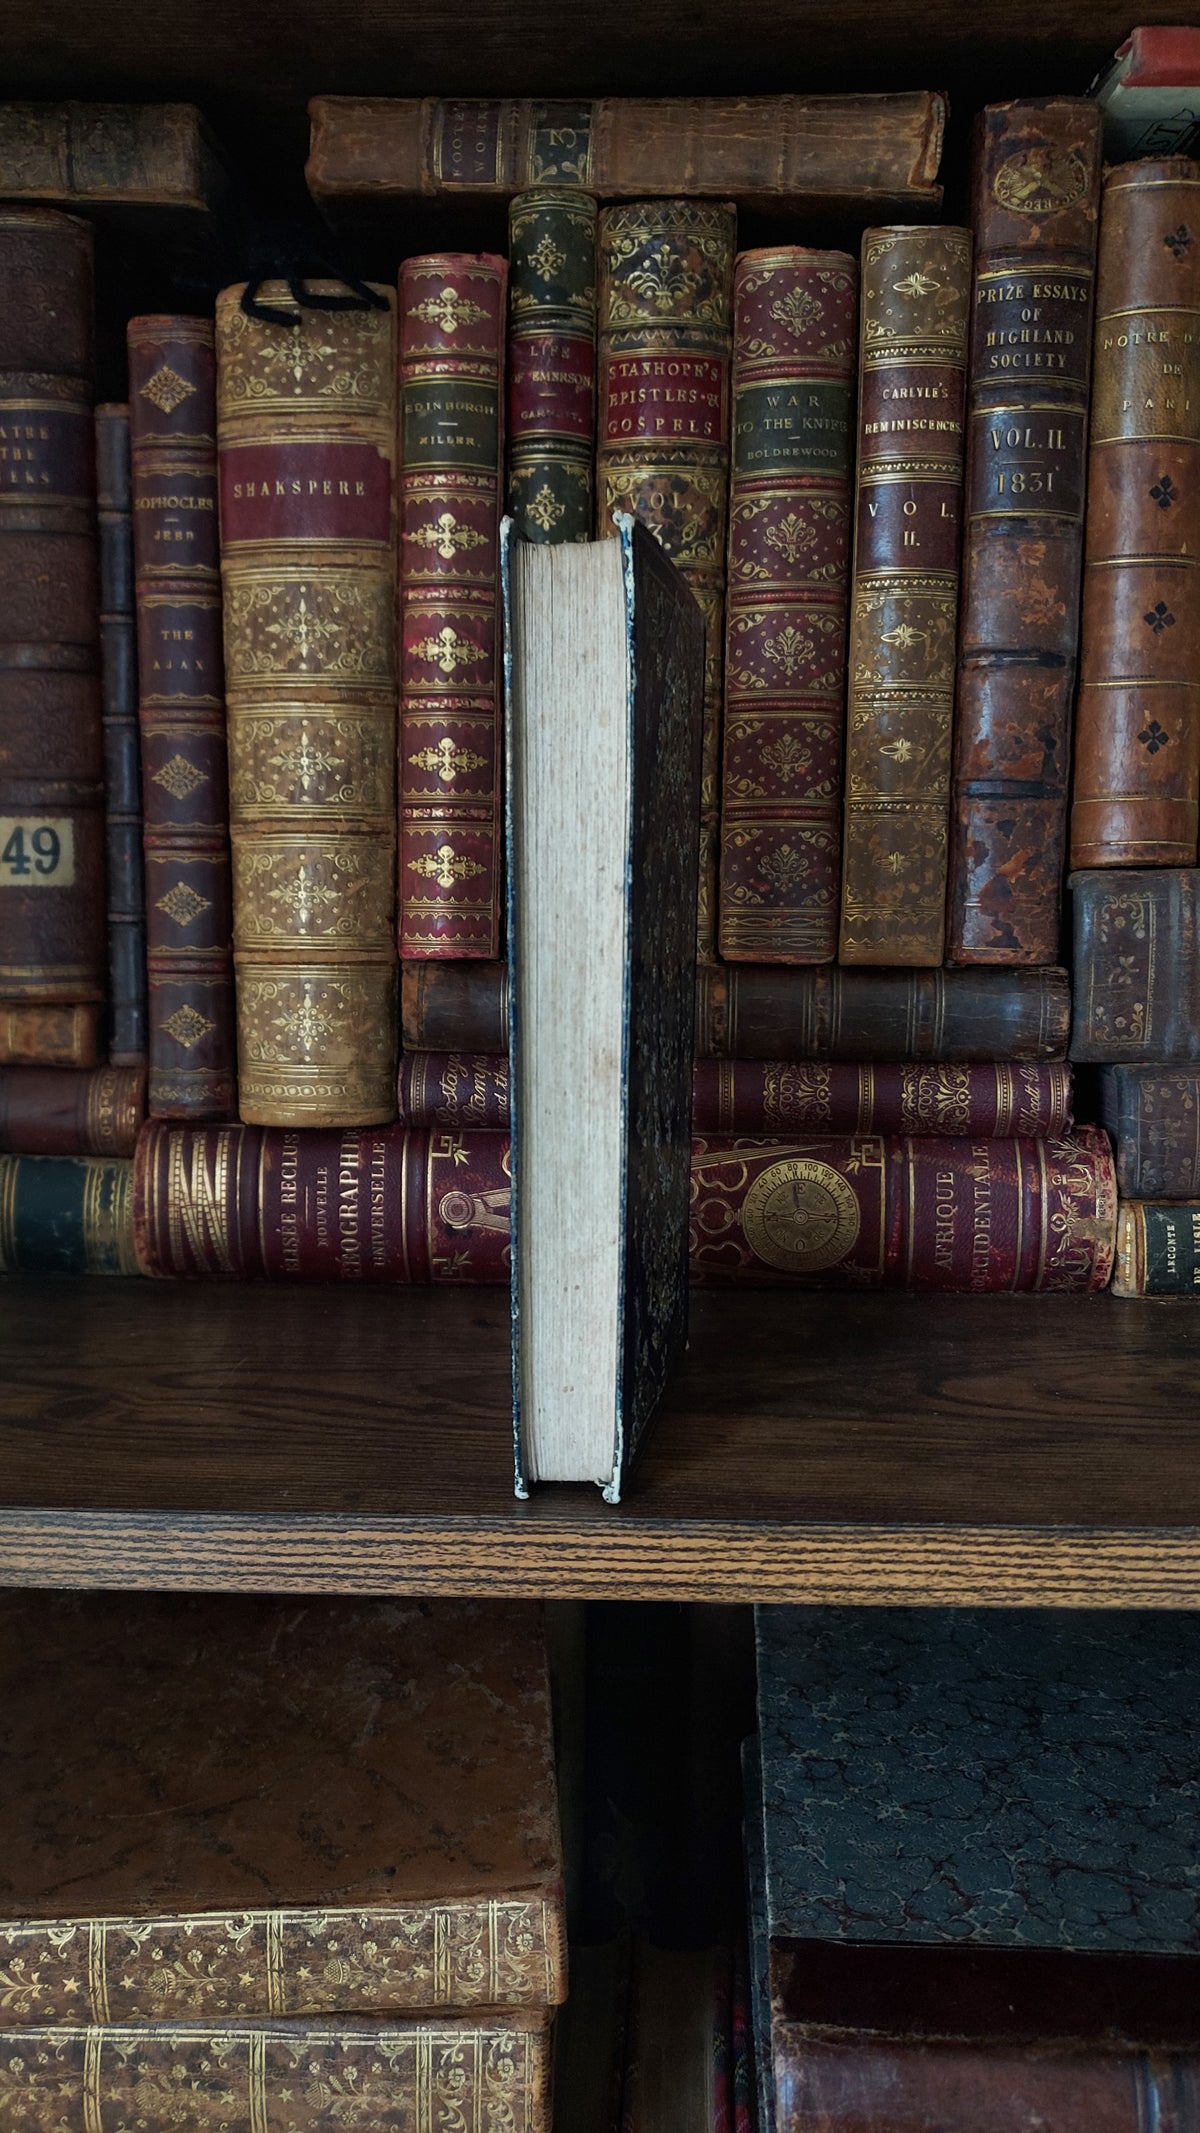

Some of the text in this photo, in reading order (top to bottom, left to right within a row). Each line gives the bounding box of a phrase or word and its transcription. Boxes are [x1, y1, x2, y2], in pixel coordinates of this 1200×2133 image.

[977, 284, 1089, 304] PRIZE ESSAYS
[1021, 308, 1043, 322] OF
[986, 329, 1075, 347] HIGHLAND
[989, 353, 1067, 369] SOCIETY
[1162, 364, 1182, 376] DE
[608, 361, 719, 382] STANHOPE'S
[882, 382, 949, 400] CARLYLE'S
[766, 395, 820, 408] WAR
[608, 416, 713, 436] GOSPELS
[763, 417, 793, 430] THE
[990, 428, 1067, 450] VOL. II.
[746, 447, 838, 461] BOLDREWOOD
[233, 479, 366, 499] SHAKSPERE
[997, 472, 1054, 494] 1831
[135, 496, 214, 511] SOPHOCLES
[629, 492, 692, 511] VOL.
[868, 500, 954, 518] VOL.
[903, 531, 921, 547] II.
[161, 629, 193, 641] THE
[152, 659, 205, 672] AJAX
[1, 825, 61, 876] 49
[433, 1053, 469, 1127] Postage
[280, 1132, 300, 1204] RECLUS
[770, 1167, 782, 1178] 60
[787, 1163, 799, 1172] 80
[804, 1163, 819, 1173] 100
[820, 1168, 834, 1180] 120
[834, 1178, 847, 1192] 140
[315, 1165, 329, 1248] NOUVELLE
[369, 1141, 387, 1268] UNIVERSELLE
[933, 1170, 955, 1271] AFRIQUE
[1166, 1225, 1177, 1274] LECONTE
